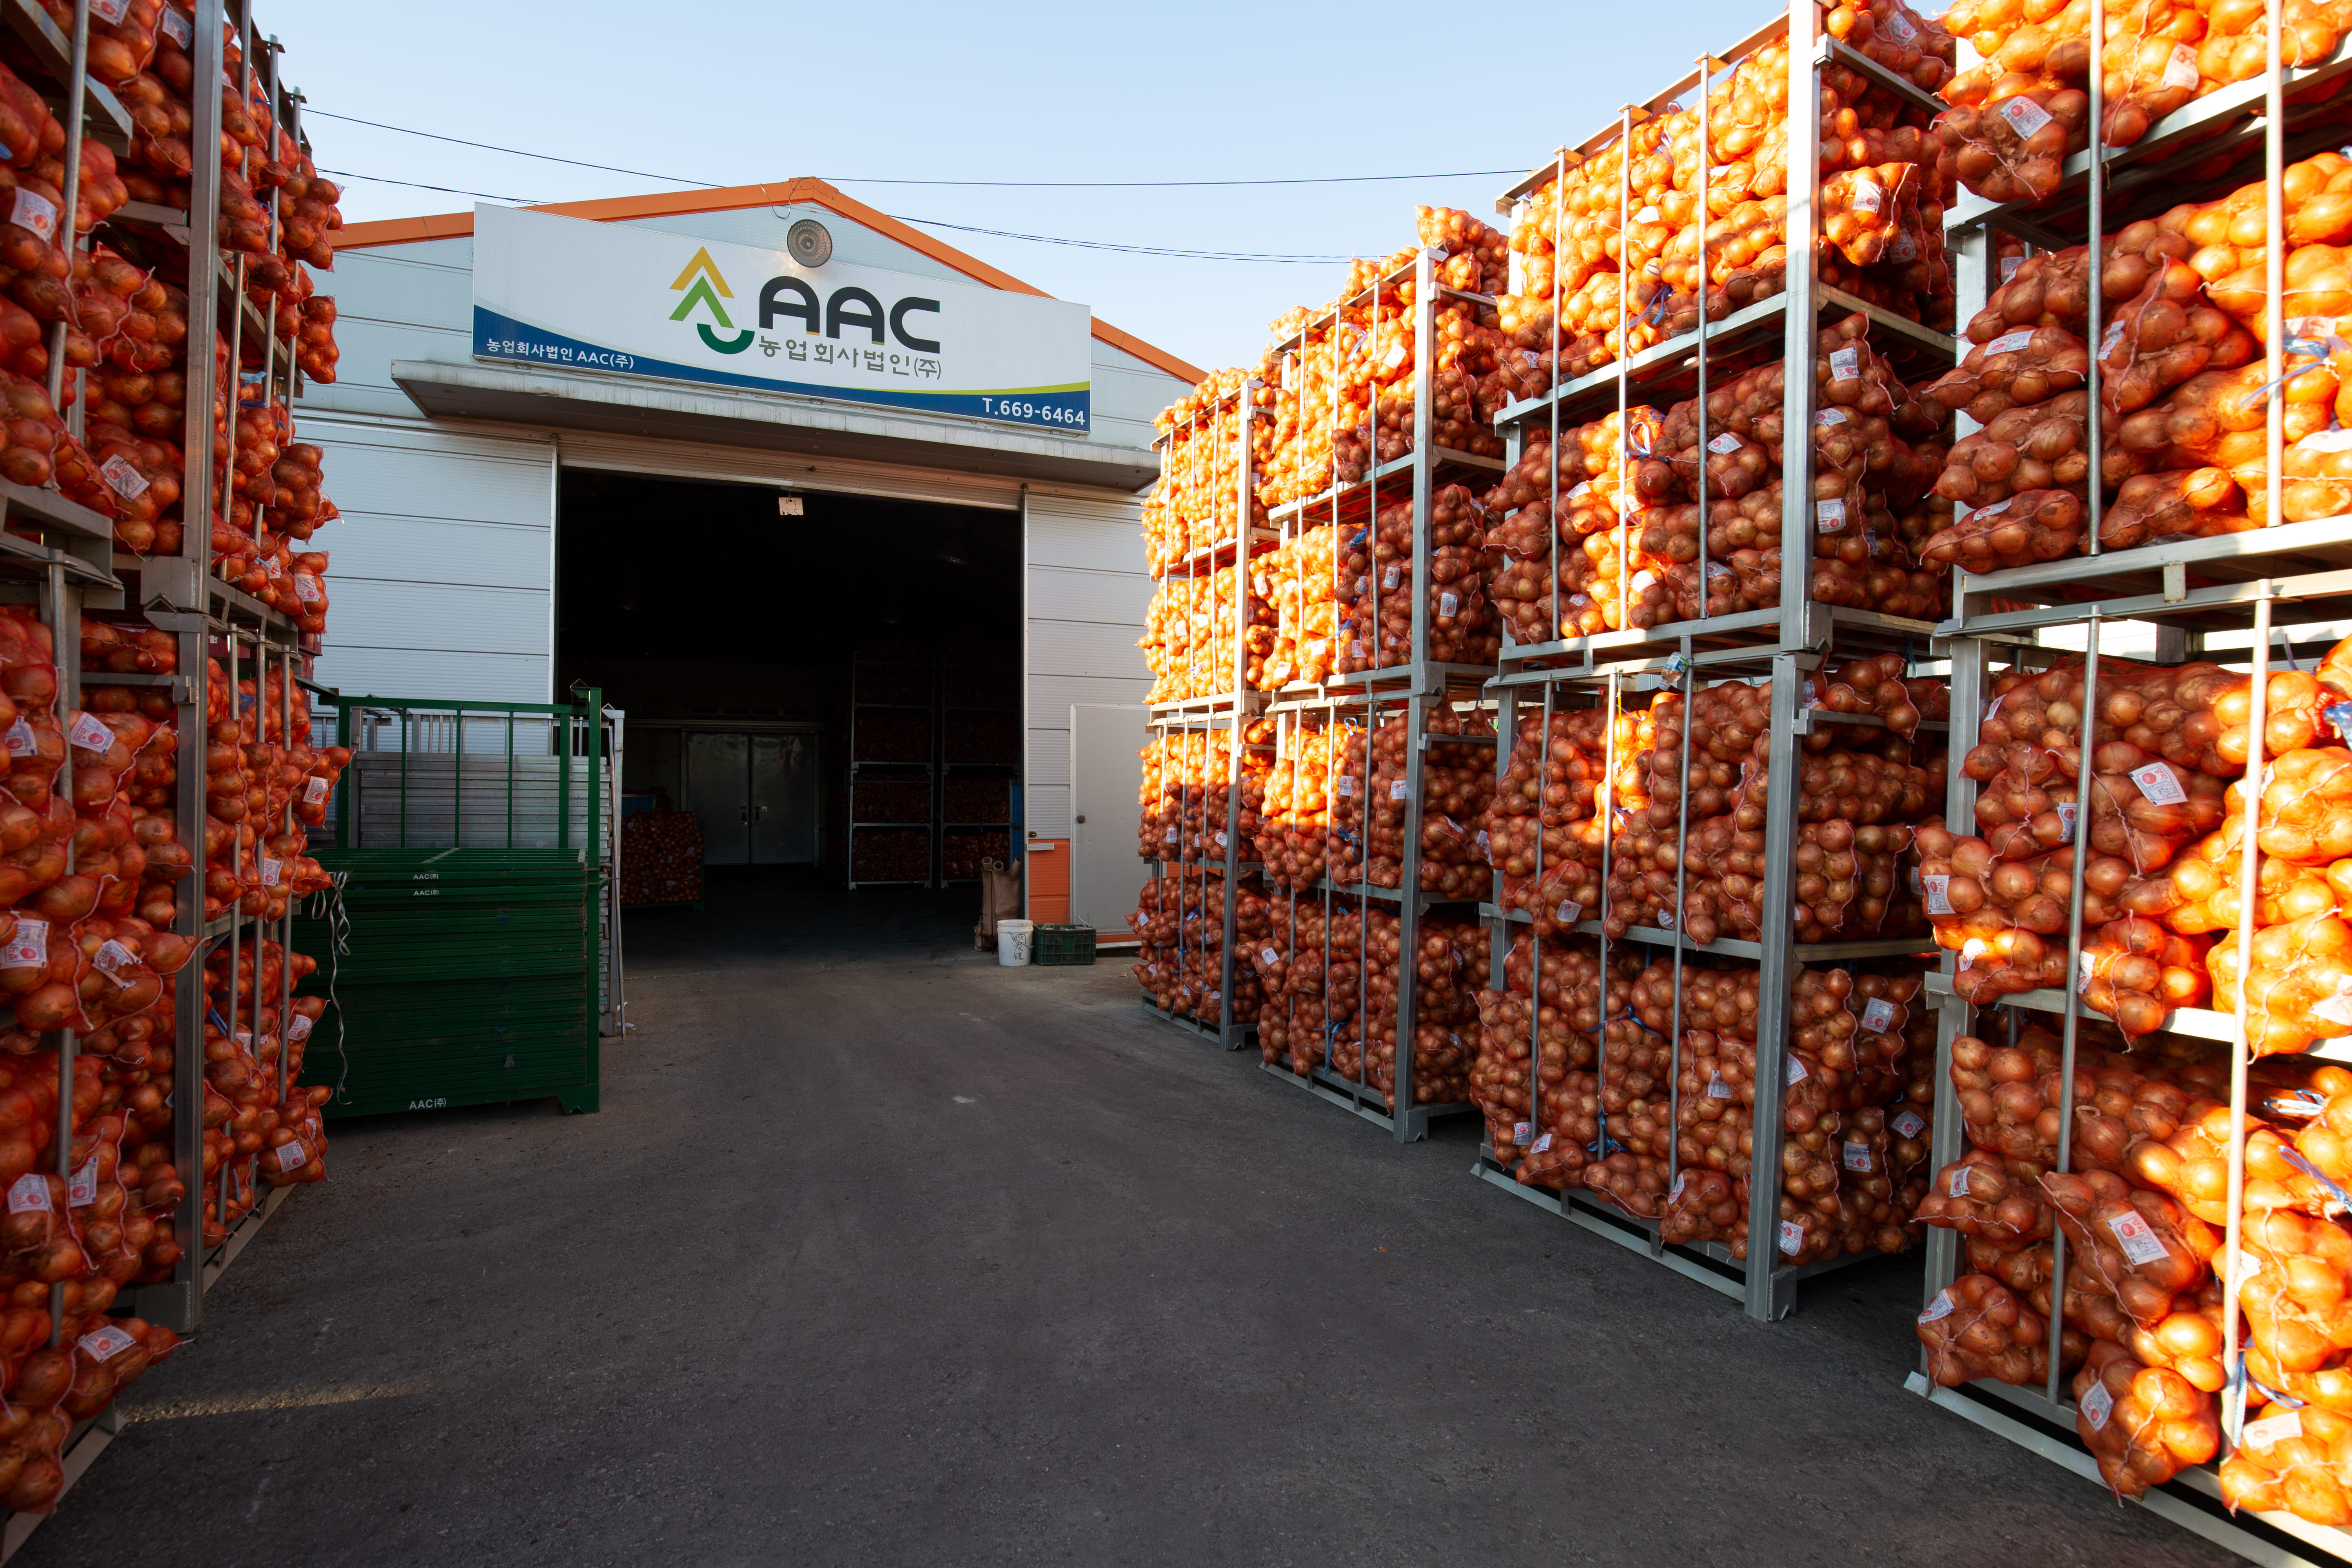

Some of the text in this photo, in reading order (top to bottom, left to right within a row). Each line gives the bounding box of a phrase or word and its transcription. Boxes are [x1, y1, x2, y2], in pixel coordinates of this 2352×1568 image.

[759, 276, 940, 354] AAC
[487, 339, 634, 369] 농업회사법인 AAC(주)
[759, 336, 941, 380] 농업회사법인(주)
[982, 397, 1085, 425] T.669-6464
[77, 728, 90, 739] 양파
[2155, 768, 2168, 780] 양파
[1938, 881, 1943, 893] 양파
[8, 947, 19, 960] 양파
[1868, 1015, 1875, 1024] 양파
[409, 1098, 446, 1110] AAC(주)
[1849, 1158, 1855, 1167] 양파
[2133, 1219, 2145, 1232] 양파
[1793, 1230, 1799, 1240] 양파
